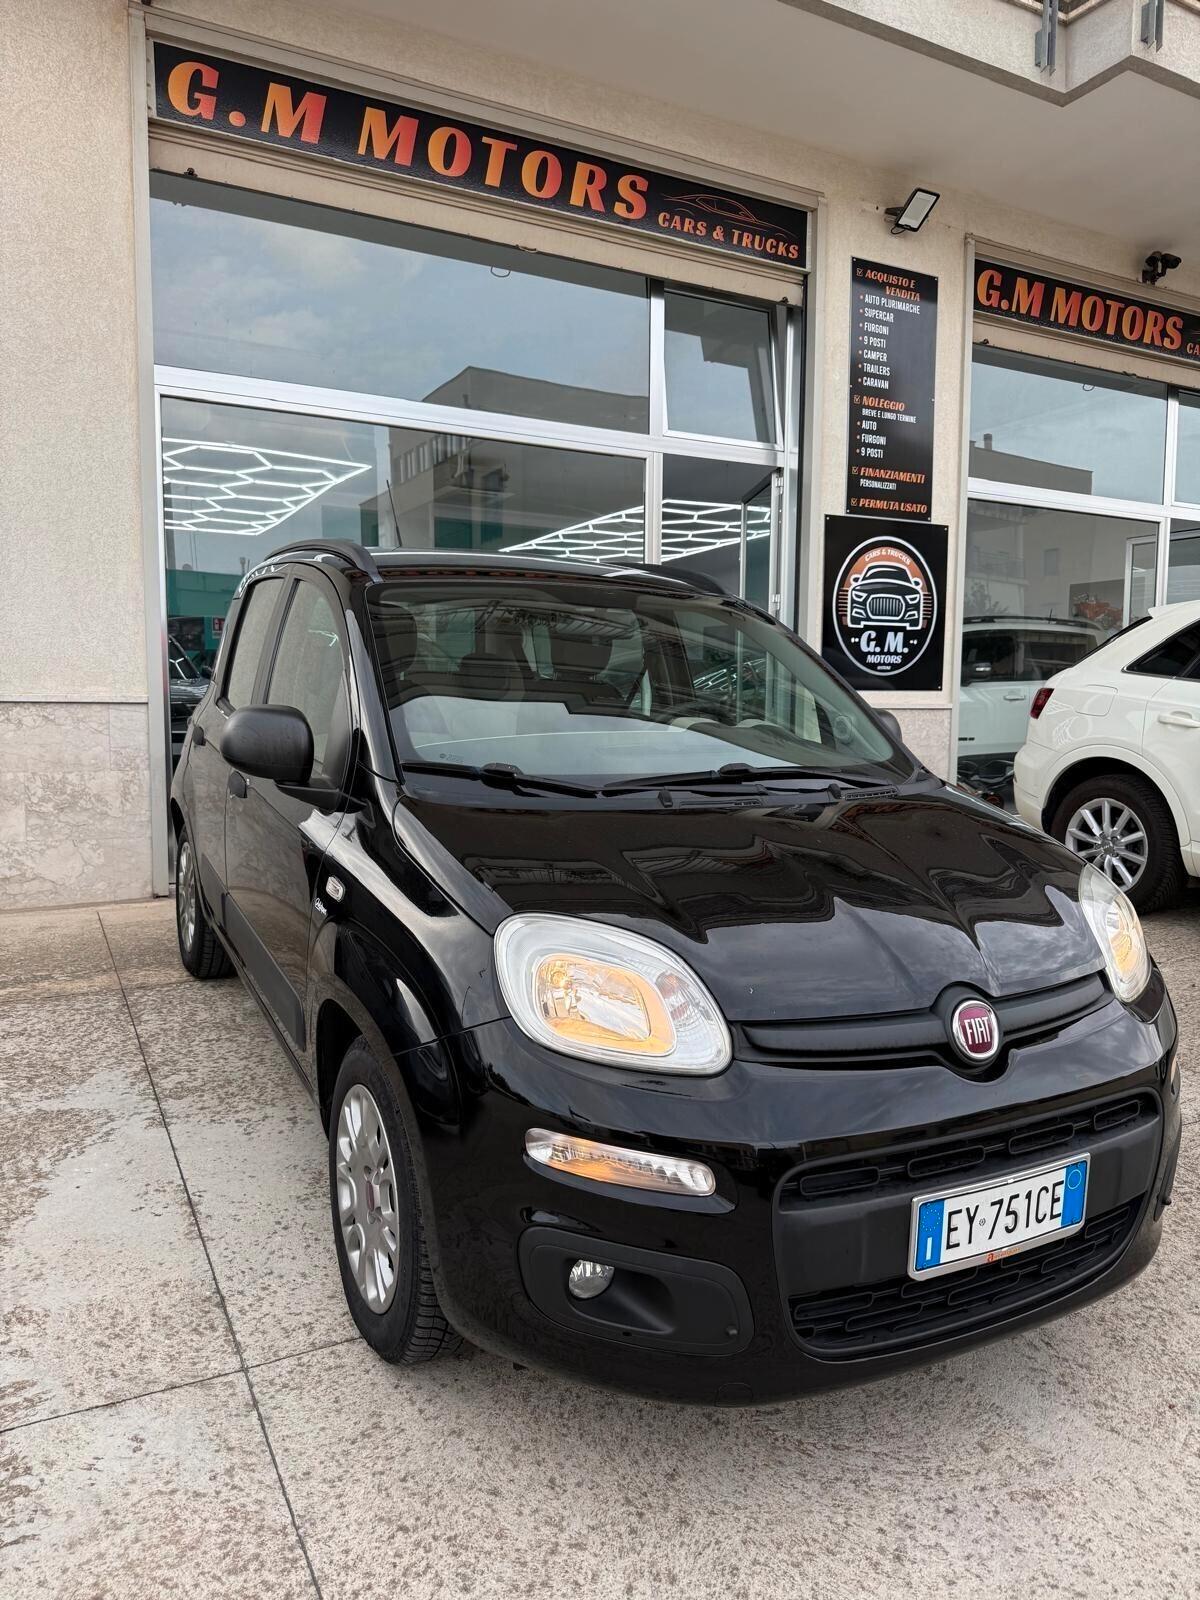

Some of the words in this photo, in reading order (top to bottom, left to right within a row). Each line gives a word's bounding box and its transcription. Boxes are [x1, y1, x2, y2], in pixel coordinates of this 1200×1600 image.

[358, 106, 649, 220] MOTORS
[658, 212, 707, 237] CARS
[712, 226, 725, 242] &
[731, 229, 799, 259] TRUCKS
[865, 269, 910, 287] ACQUISTO
[910, 280, 916, 289] E
[885, 286, 920, 302] VENDITA
[865, 294, 879, 305] AUTO
[881, 297, 920, 315] PLURIMARCHE
[864, 308, 894, 322] SUPERCAR
[1050, 287, 1184, 350] MOTORS
[864, 322, 889, 335] FURGONI
[864, 335, 868, 344] 9
[869, 337, 886, 348] POSTI
[864, 349, 887, 361] CAMPER
[864, 363, 890, 376] TRAILERS
[863, 376, 889, 389] CARAVAN
[862, 396, 905, 411] NOLEGGIO
[862, 408, 877, 417] BREVE
[882, 411, 896, 420] LUNGO
[897, 414, 916, 423] TERMINE
[862, 420, 877, 430] AUTO
[861, 434, 886, 445] FURGONI
[861, 447, 866, 456] 9
[867, 448, 884, 458] POSTI
[860, 467, 925, 484] FINANZIAMENTI
[860, 479, 896, 490] PERSONALIZZATI
[859, 498, 899, 511] PERMUTA
[900, 503, 927, 513] USATO
[864, 550, 881, 561] CARS
[887, 550, 910, 565] TRUCKS
[866, 654, 902, 664] MOTORS
[964, 1017, 990, 1045] FIAT
